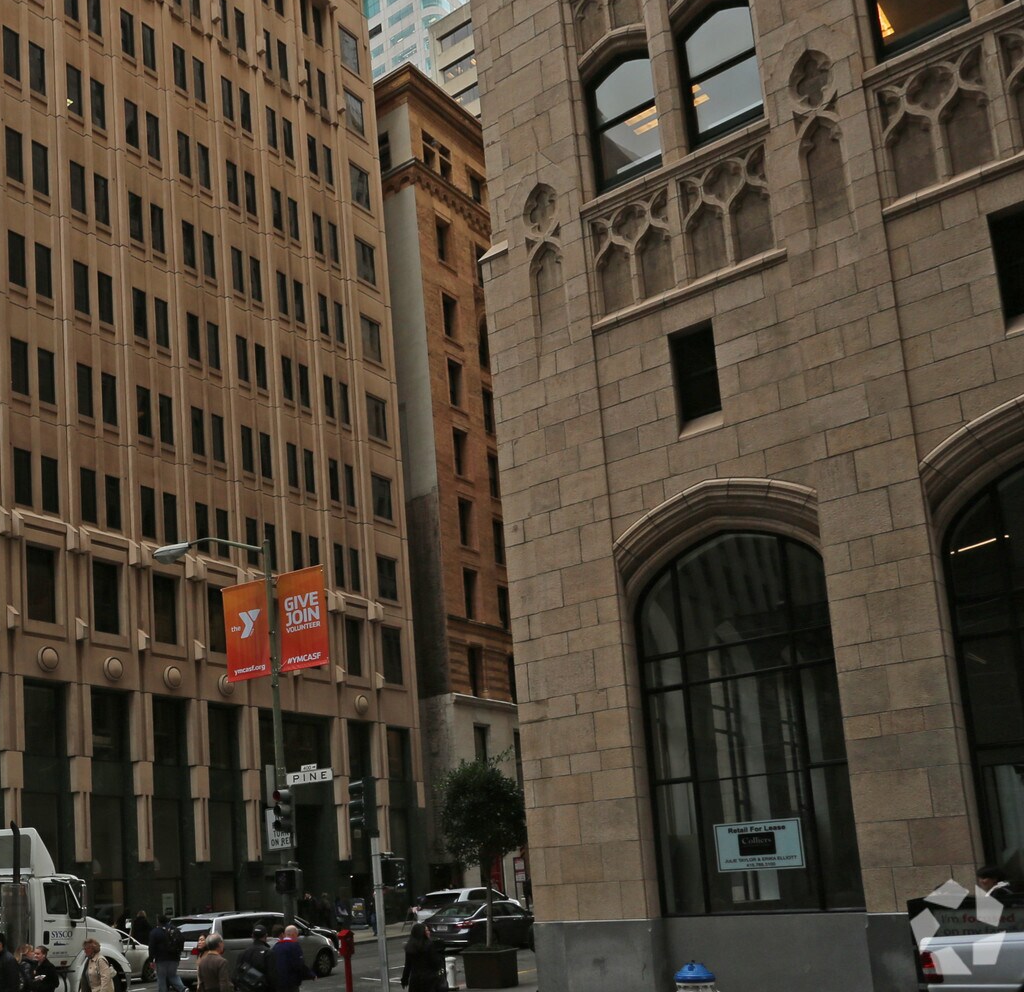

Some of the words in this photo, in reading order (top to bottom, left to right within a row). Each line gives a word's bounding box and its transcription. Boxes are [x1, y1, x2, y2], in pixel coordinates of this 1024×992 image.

[284, 591, 319, 612] GIVE
[286, 605, 320, 627] JOIN
[231, 625, 241, 633] the
[286, 621, 321, 633] VOLUNTEER
[287, 652, 321, 664] #YMCASF
[234, 664, 266, 676] ymcasf.org
[292, 771, 327, 783] PINE
[727, 826, 748, 834] Retail
[764, 824, 786, 832] Lease
[271, 838, 279, 847] ON
[281, 837, 291, 846] RE
[741, 836, 772, 845] Colliers
[962, 912, 1016, 923] foed
